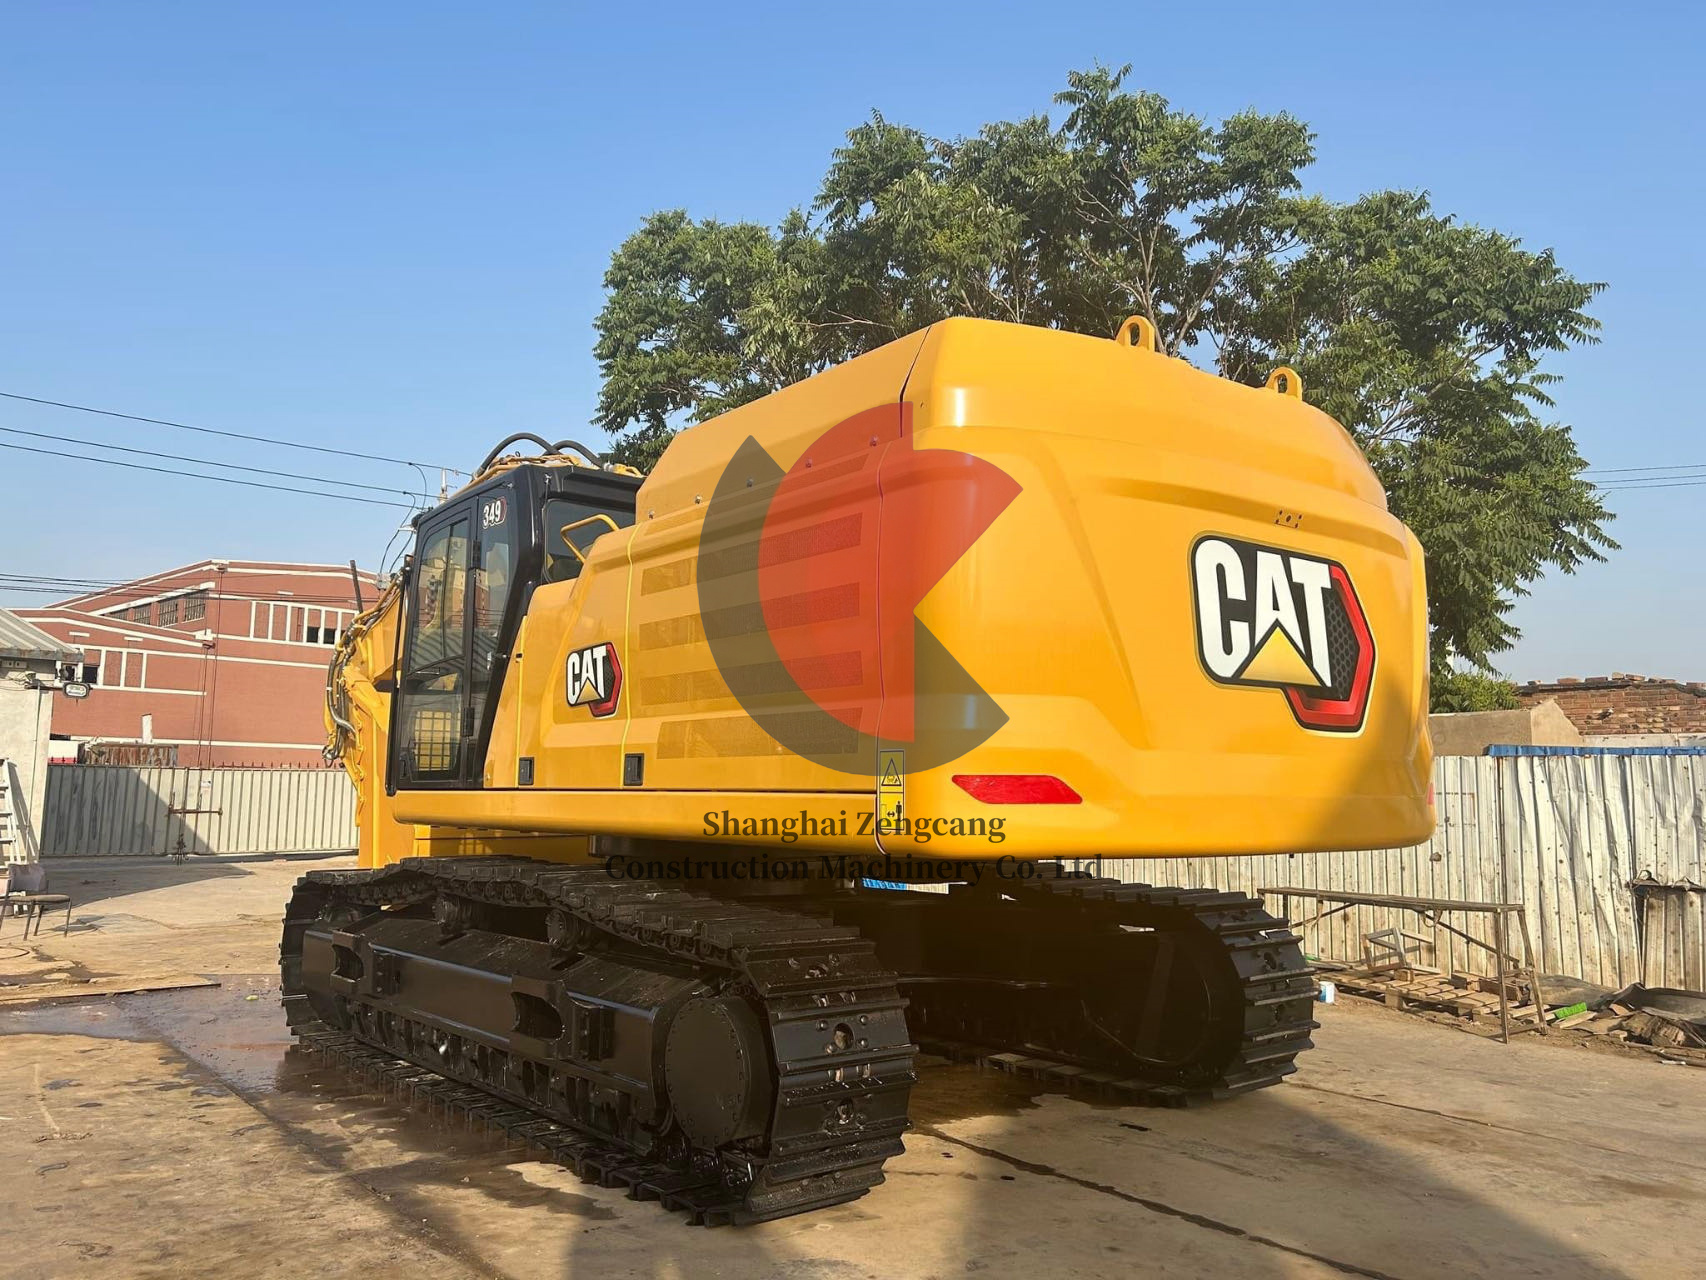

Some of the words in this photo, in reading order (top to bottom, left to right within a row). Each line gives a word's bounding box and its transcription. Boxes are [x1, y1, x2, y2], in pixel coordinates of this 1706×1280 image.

[483, 500, 501, 527] 349
[1194, 539, 1332, 687] CAT
[567, 645, 606, 705] CAT
